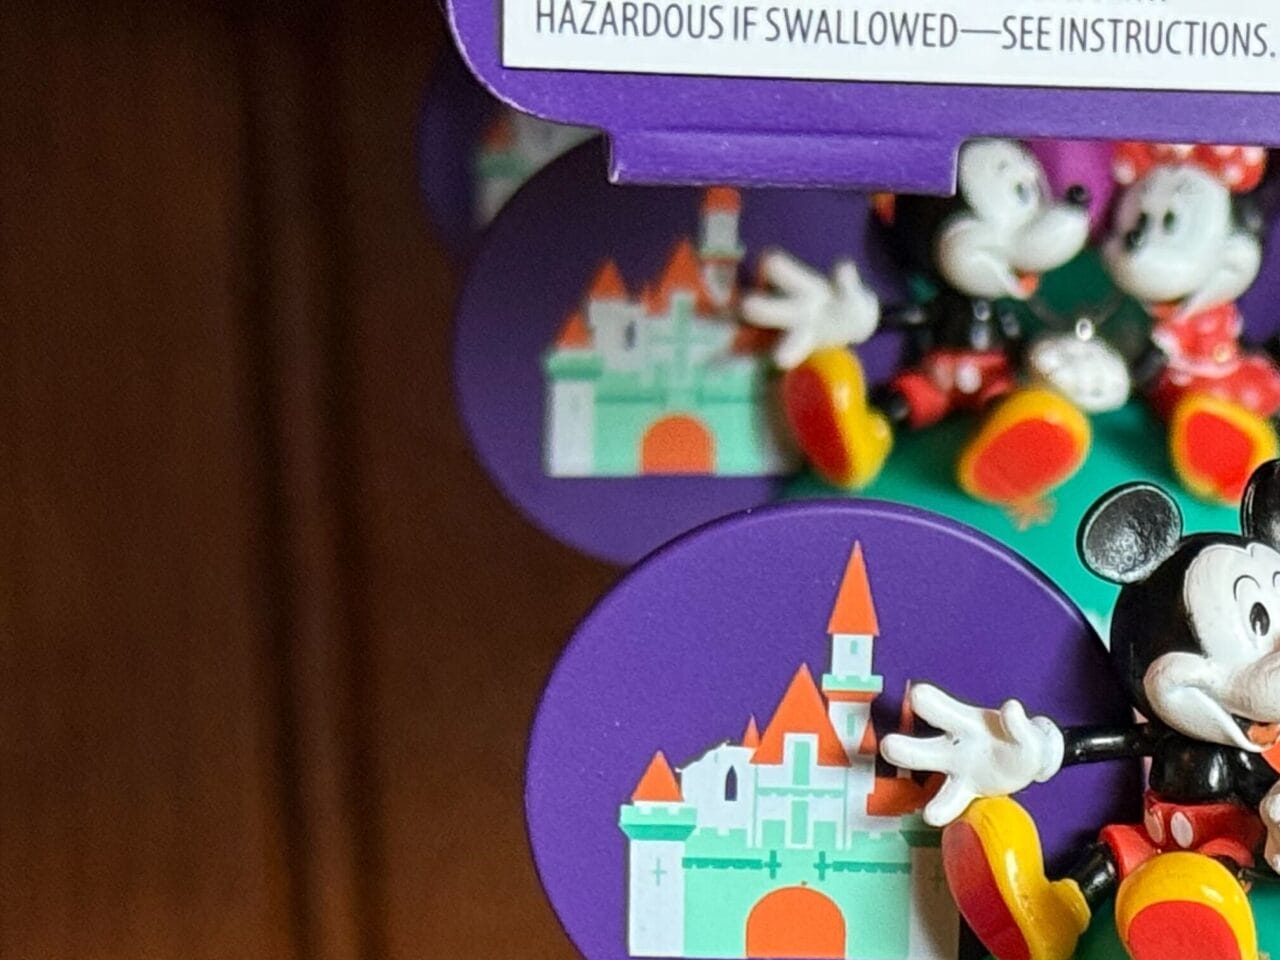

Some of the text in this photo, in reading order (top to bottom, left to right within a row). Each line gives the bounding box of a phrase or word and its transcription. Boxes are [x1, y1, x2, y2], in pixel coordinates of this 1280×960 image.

[535, 0, 725, 39] HAZARDOUS
[732, 6, 758, 41] IF
[1059, 17, 1277, 58] INSTRUCTIONS.
